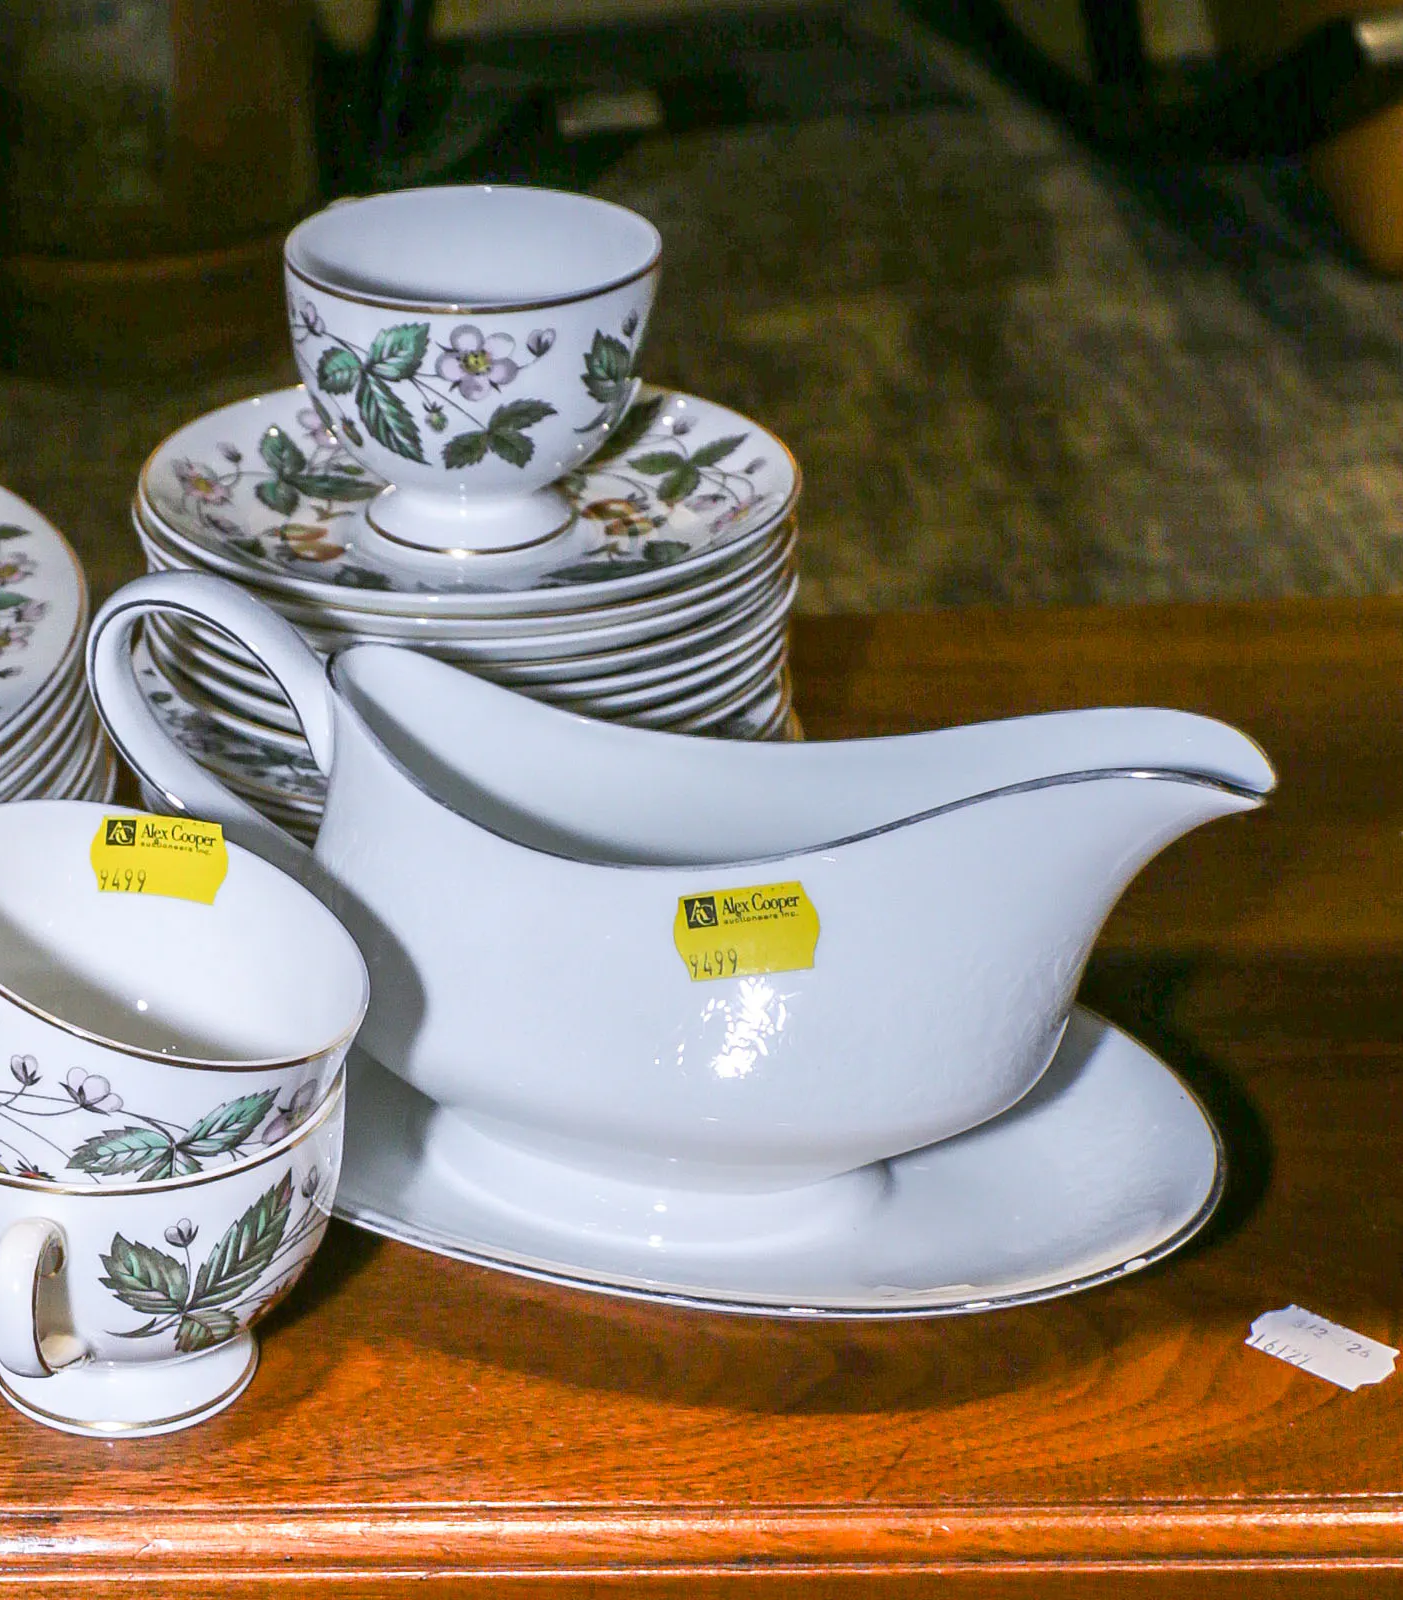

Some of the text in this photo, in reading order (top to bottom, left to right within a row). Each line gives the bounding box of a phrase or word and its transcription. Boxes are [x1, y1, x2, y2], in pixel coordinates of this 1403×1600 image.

[141, 823, 217, 848] Alex Cooper
[100, 868, 147, 893] 9499
[722, 892, 800, 915] Alex Cooper
[723, 913, 778, 925] auctioneers
[689, 948, 738, 978] 9499
